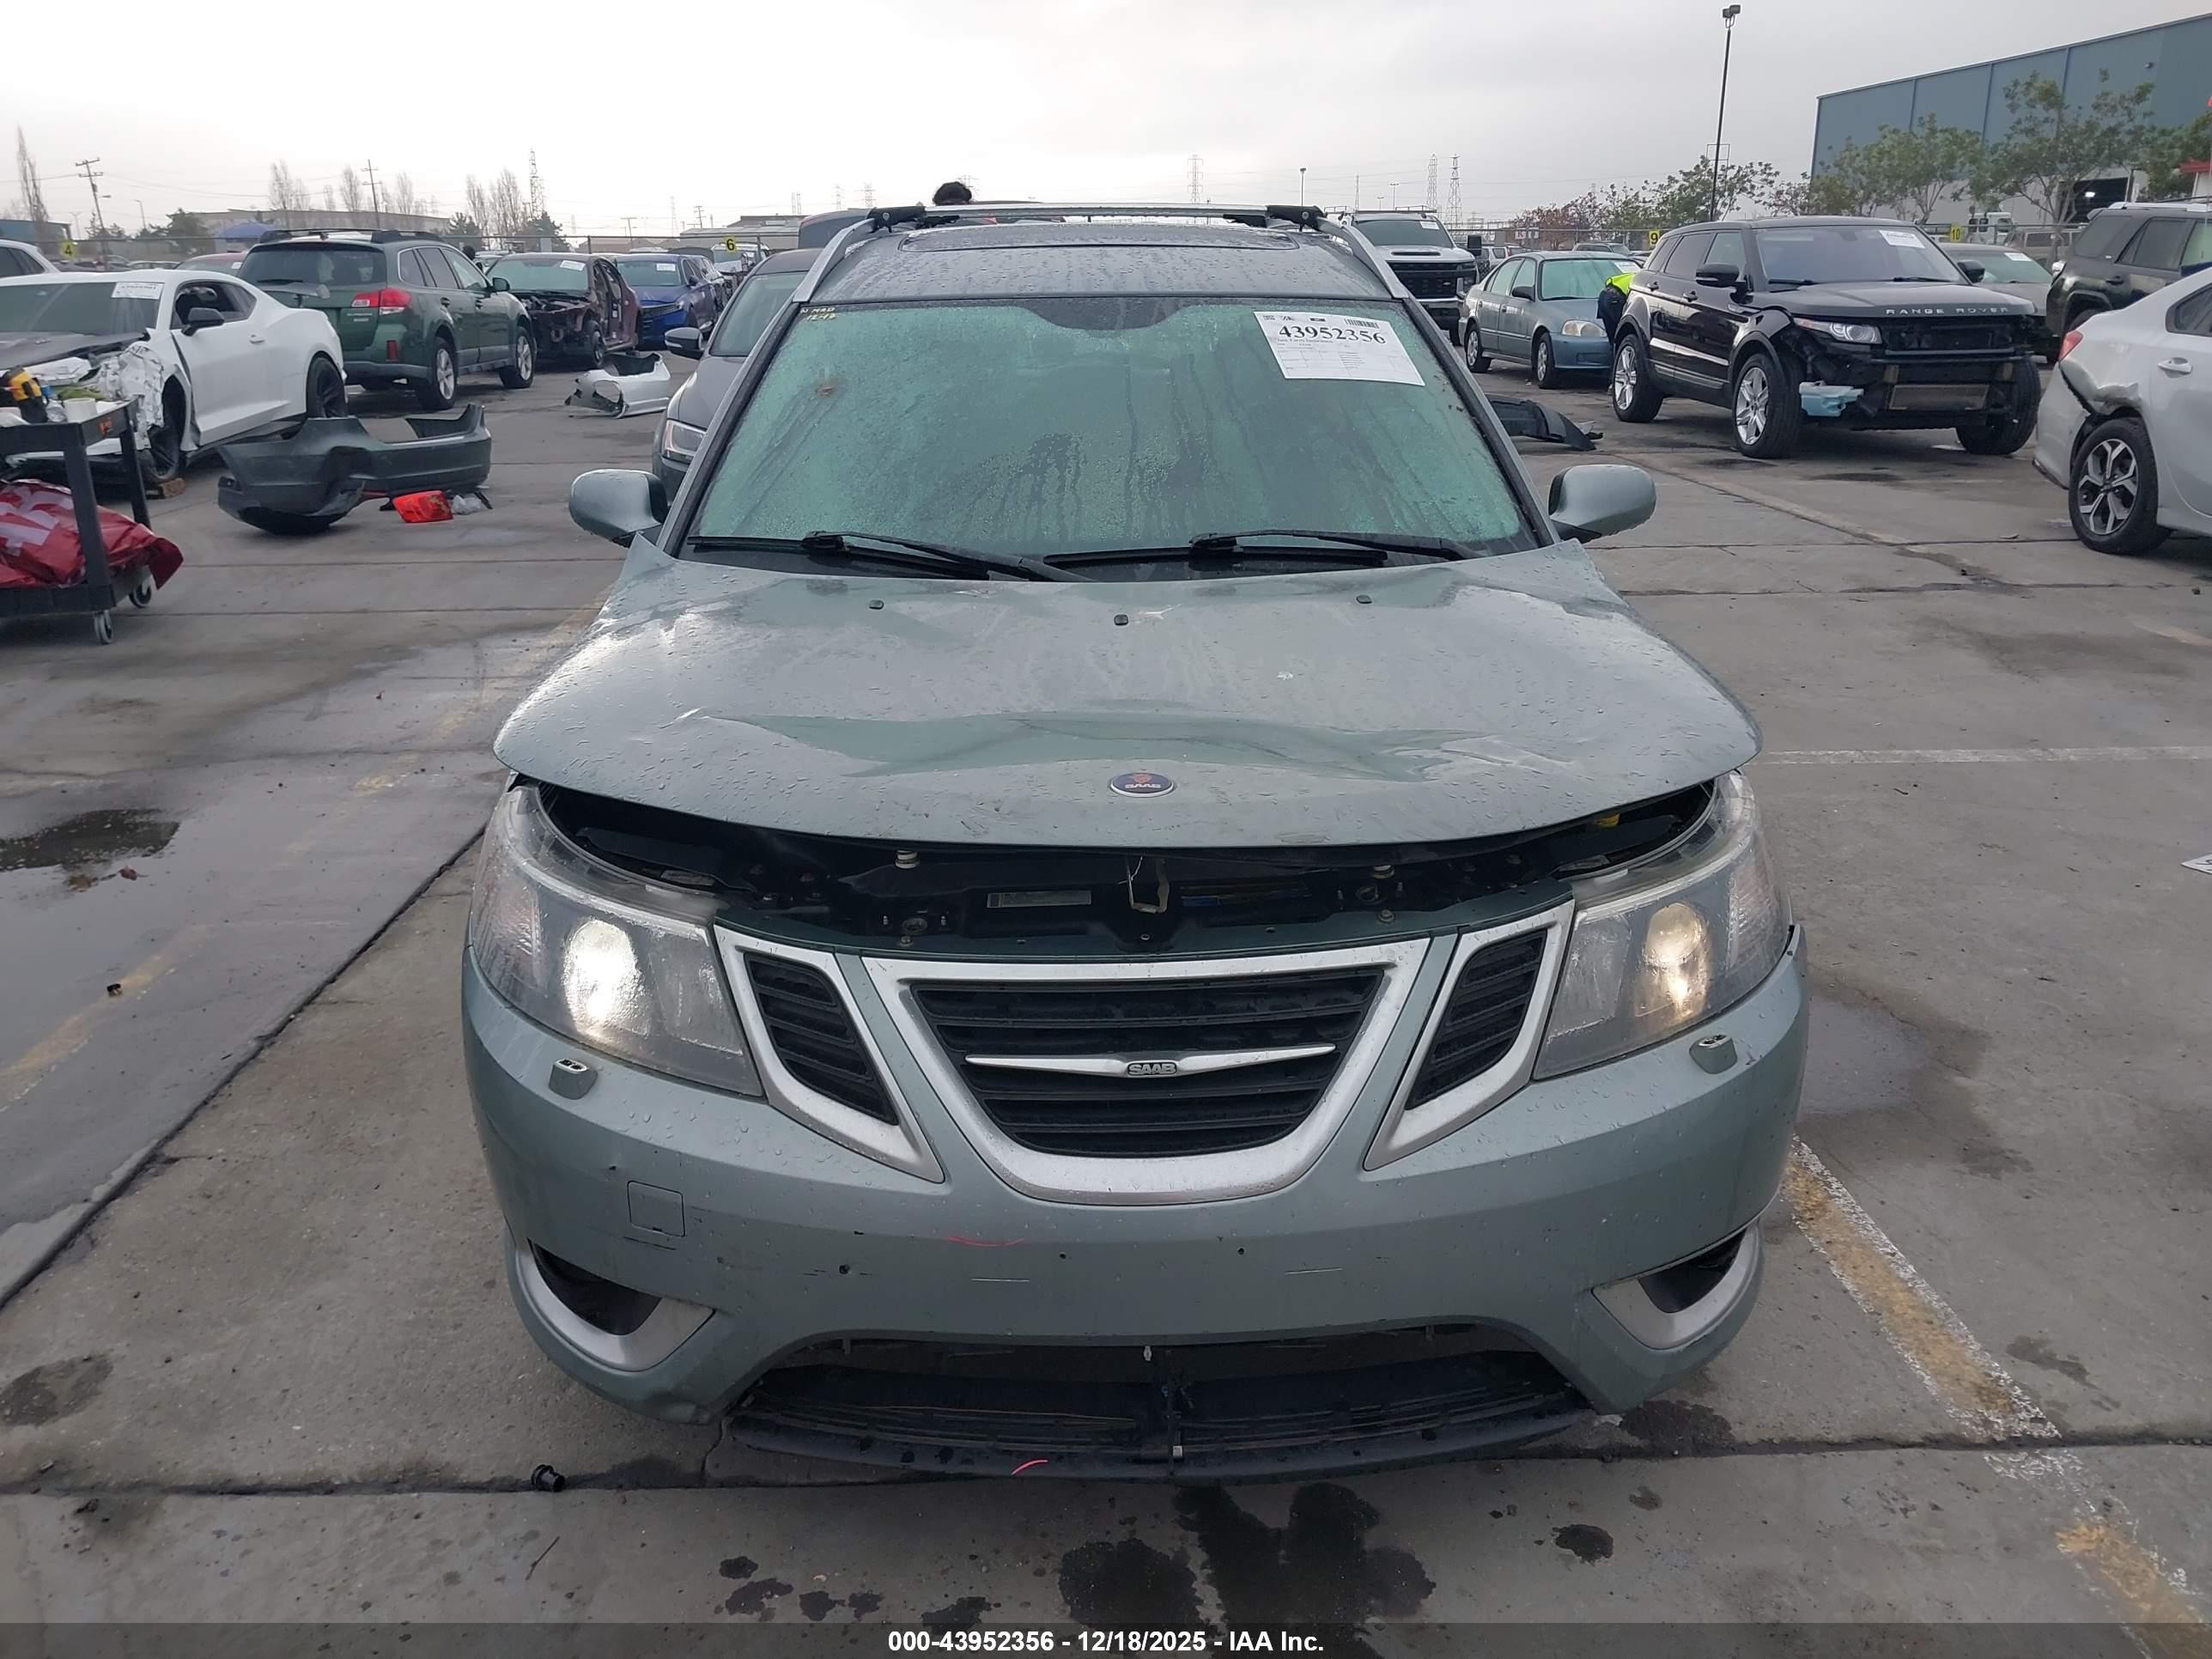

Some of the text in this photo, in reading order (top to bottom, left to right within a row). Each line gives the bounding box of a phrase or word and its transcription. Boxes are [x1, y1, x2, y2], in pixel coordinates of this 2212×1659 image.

[1650, 233, 1658, 245] 9
[1952, 228, 1960, 240] 10
[64, 244, 73, 256] 4
[726, 239, 735, 251] 6
[1279, 325, 1386, 343] 43952356
[1128, 1063, 1176, 1075] SAAB
